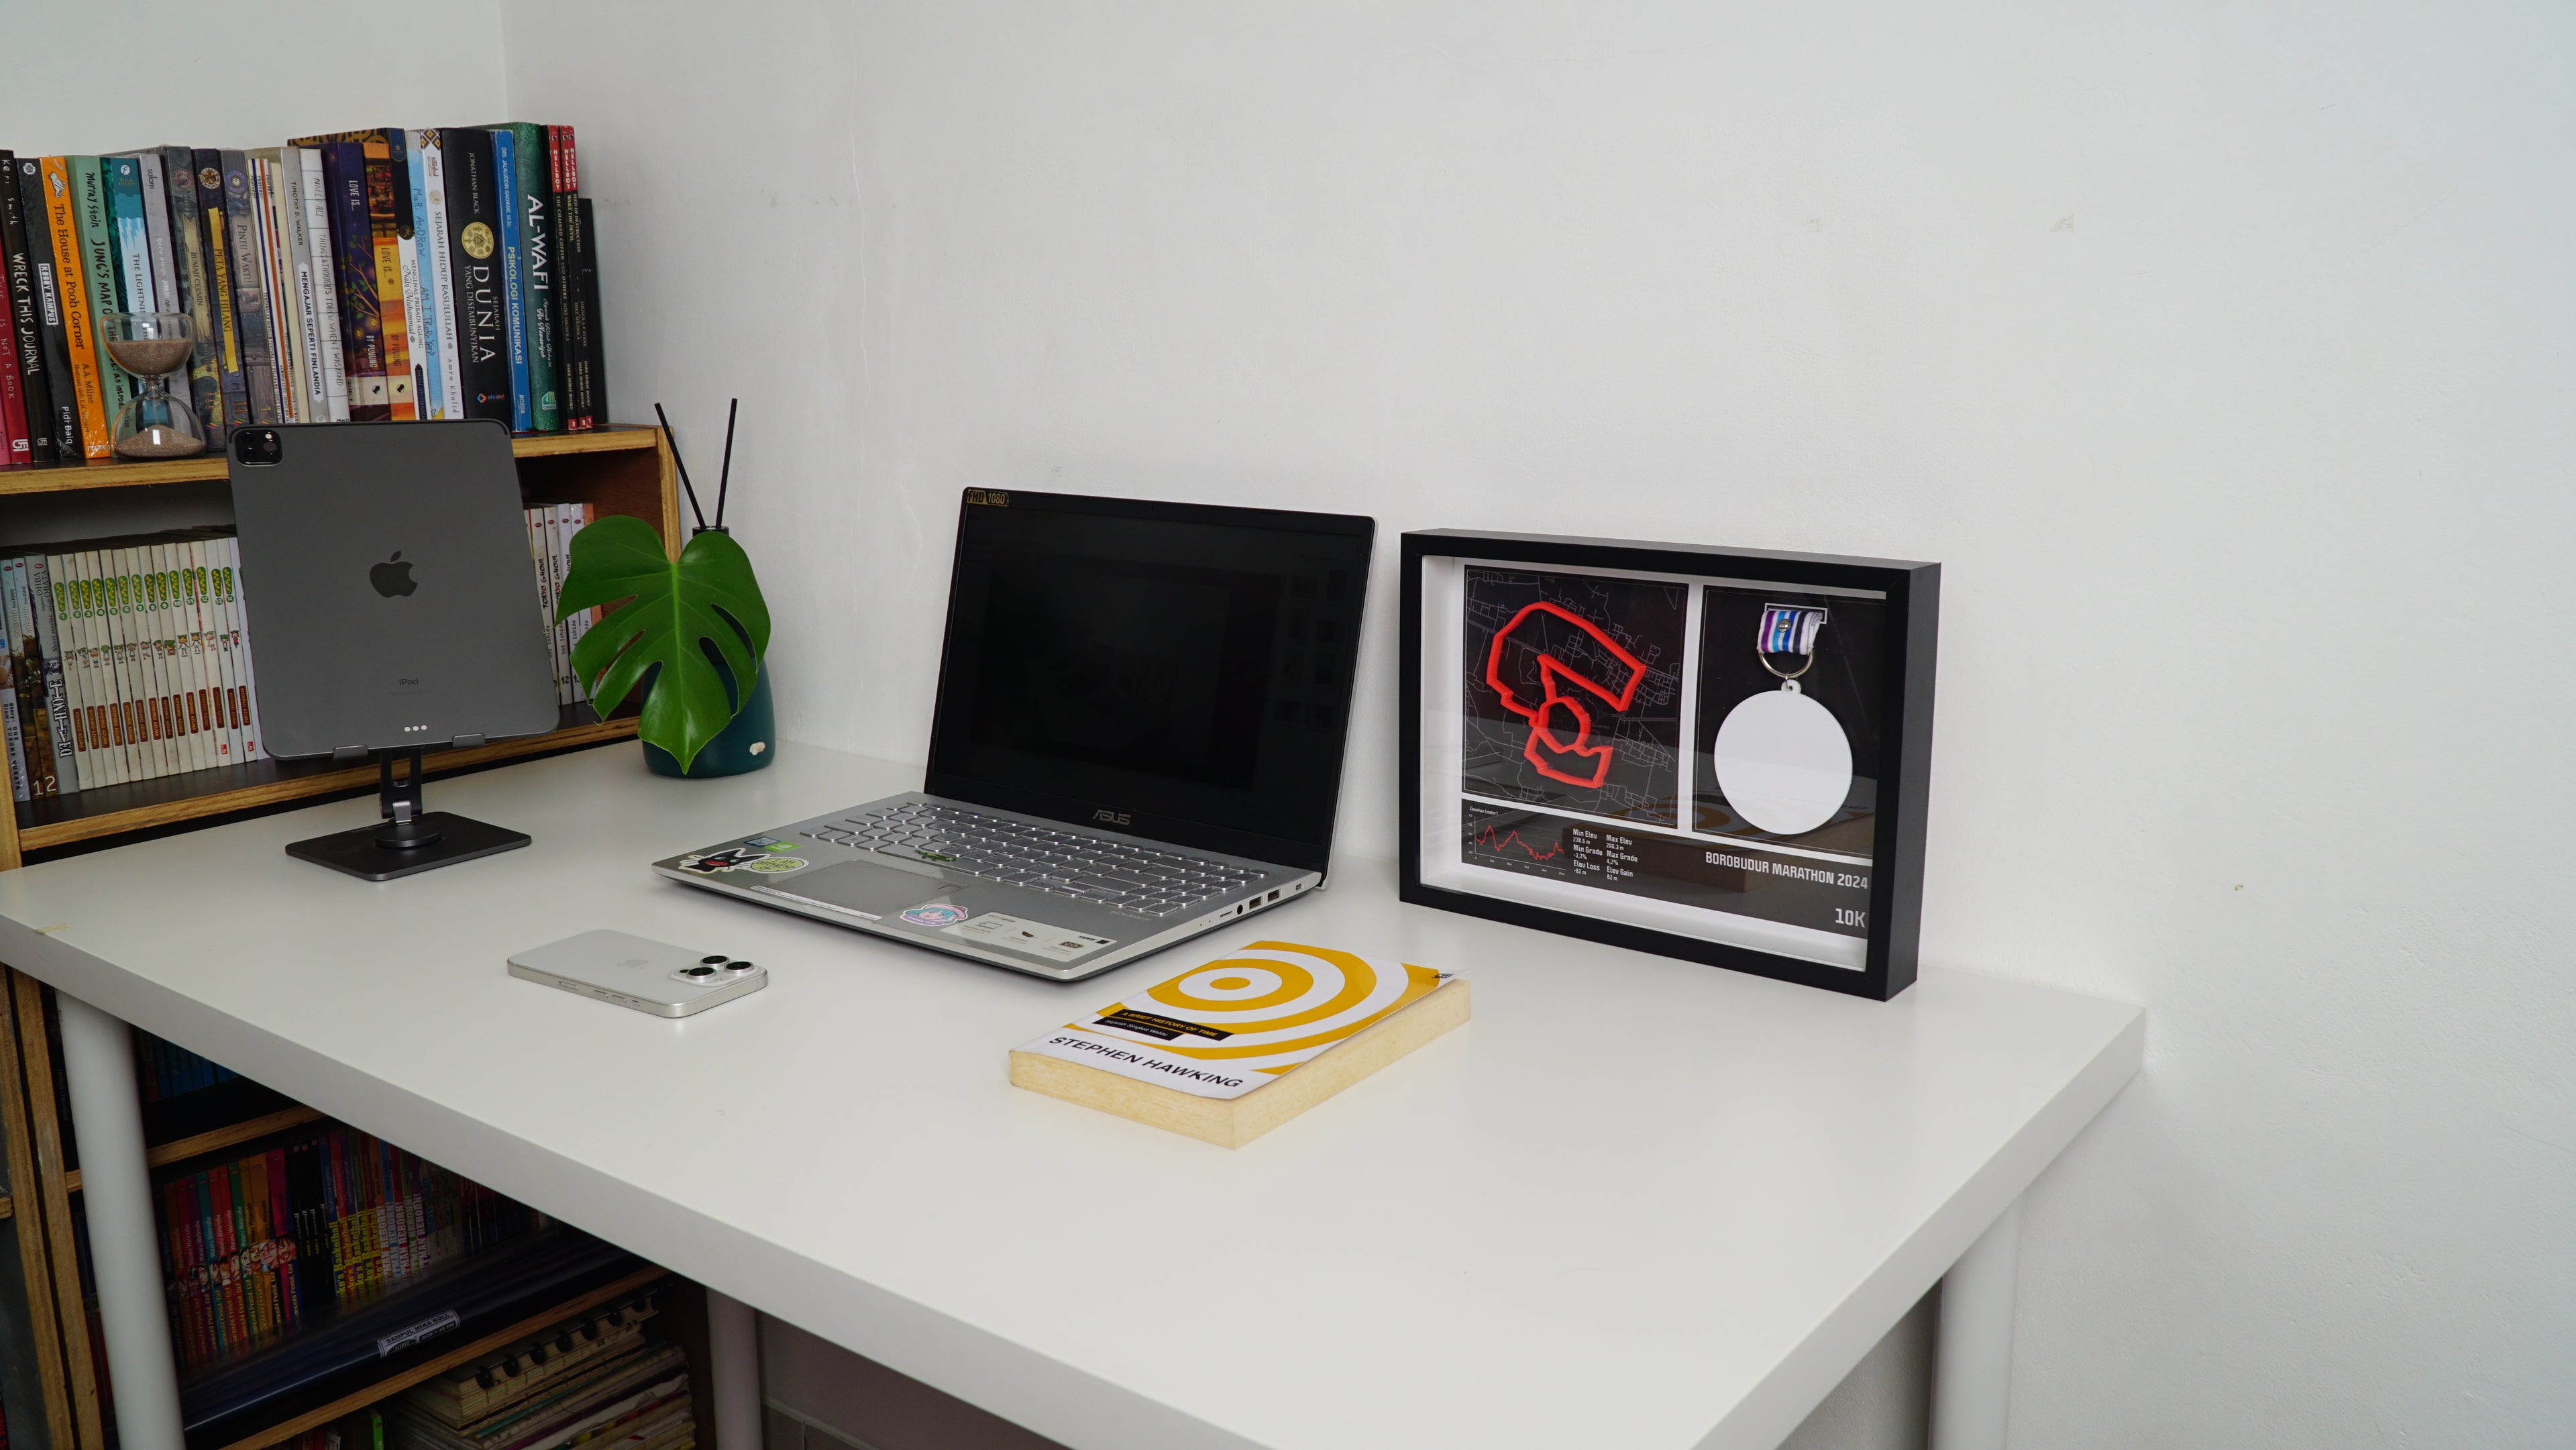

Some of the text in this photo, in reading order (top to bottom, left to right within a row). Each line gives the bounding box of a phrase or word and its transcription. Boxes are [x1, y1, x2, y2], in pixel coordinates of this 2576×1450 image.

[147, 168, 158, 189] salam
[468, 152, 478, 191] JONATHAN
[1, 159, 19, 225] Keri Smith
[85, 172, 101, 228] Murray Stein
[291, 182, 299, 210] TIMOTHY
[349, 180, 360, 197] LOVE
[435, 211, 445, 248] SEJARAH
[527, 194, 549, 290] AL-WAFI
[237, 225, 252, 283] PINTU WAKTU
[381, 248, 391, 263] LOVE
[439, 252, 448, 282] HIDUP
[54, 203, 85, 350] The House at Pooh Corner
[91, 238, 112, 305] JUNG'S MAP
[191, 252, 203, 306] RUMAH CERMIN
[411, 260, 419, 296] MENGENAL
[508, 247, 518, 300] PSIKOLOGI
[215, 249, 231, 332] PETA YANG HILANG
[402, 264, 416, 334] Nabi Muhammad
[421, 287, 430, 301] AM
[12, 252, 40, 376] WRECK THIS JOURNAL
[45, 292, 56, 323] KAMPUS
[326, 303, 335, 321] DREW
[441, 284, 453, 340] RASULULLAH
[464, 265, 479, 363] YANG DISEMBUNYIKAN
[473, 266, 496, 362] DUNIA
[1, 338, 11, 356] NOT
[301, 271, 321, 395] MENGAJAR SEPERTI FINLANDIA
[329, 323, 337, 346] WHEN
[512, 303, 523, 364] KOMUNIKASI
[368, 344, 378, 368] PUUUNG
[85, 380, 95, 403] Milne
[61, 406, 74, 444] Pidi Baiq
[968, 490, 1006, 505] FHD 1080
[34, 572, 43, 596] OHBA
[41, 570, 50, 598] OBATA
[537, 557, 546, 583] GHOUL
[11, 609, 21, 638] solanin
[23, 606, 32, 634] solanin
[399, 678, 419, 686] iPad
[561, 676, 570, 684] 12
[7, 727, 16, 757] YUSUKE
[34, 780, 44, 796] 1
[45, 776, 57, 792] 2
[1092, 809, 1132, 825] ASUS
[1573, 829, 1597, 839] Min Elev
[1606, 834, 1632, 845] Max Elev
[1573, 844, 1603, 856] Min Grade
[1606, 850, 1638, 862] Max Grade
[1574, 860, 1585, 868] Elev
[1587, 862, 1600, 871] Loss
[1607, 866, 1633, 877] Elev Gain
[1706, 851, 1868, 890] BOROBUDUR MARATHON 2024
[1835, 908, 1866, 928] 10K
[1104, 1019, 1127, 1028] Sejarah
[1128, 1013, 1152, 1021] BRIEF
[1152, 1017, 1186, 1031] HISTORY
[1198, 1028, 1219, 1037] TIME
[1049, 1037, 1244, 1088] STEPHEN HAWKING
[225, 1210, 233, 1233] Watanabe
[236, 1206, 244, 1230] Watanabe
[413, 1193, 426, 1235] REBORN!
[329, 1221, 344, 1272] Basketball
[386, 1329, 414, 1343] SAMPUL
[414, 1321, 432, 1331] MIKA
[433, 1313, 451, 1323] ROLL
